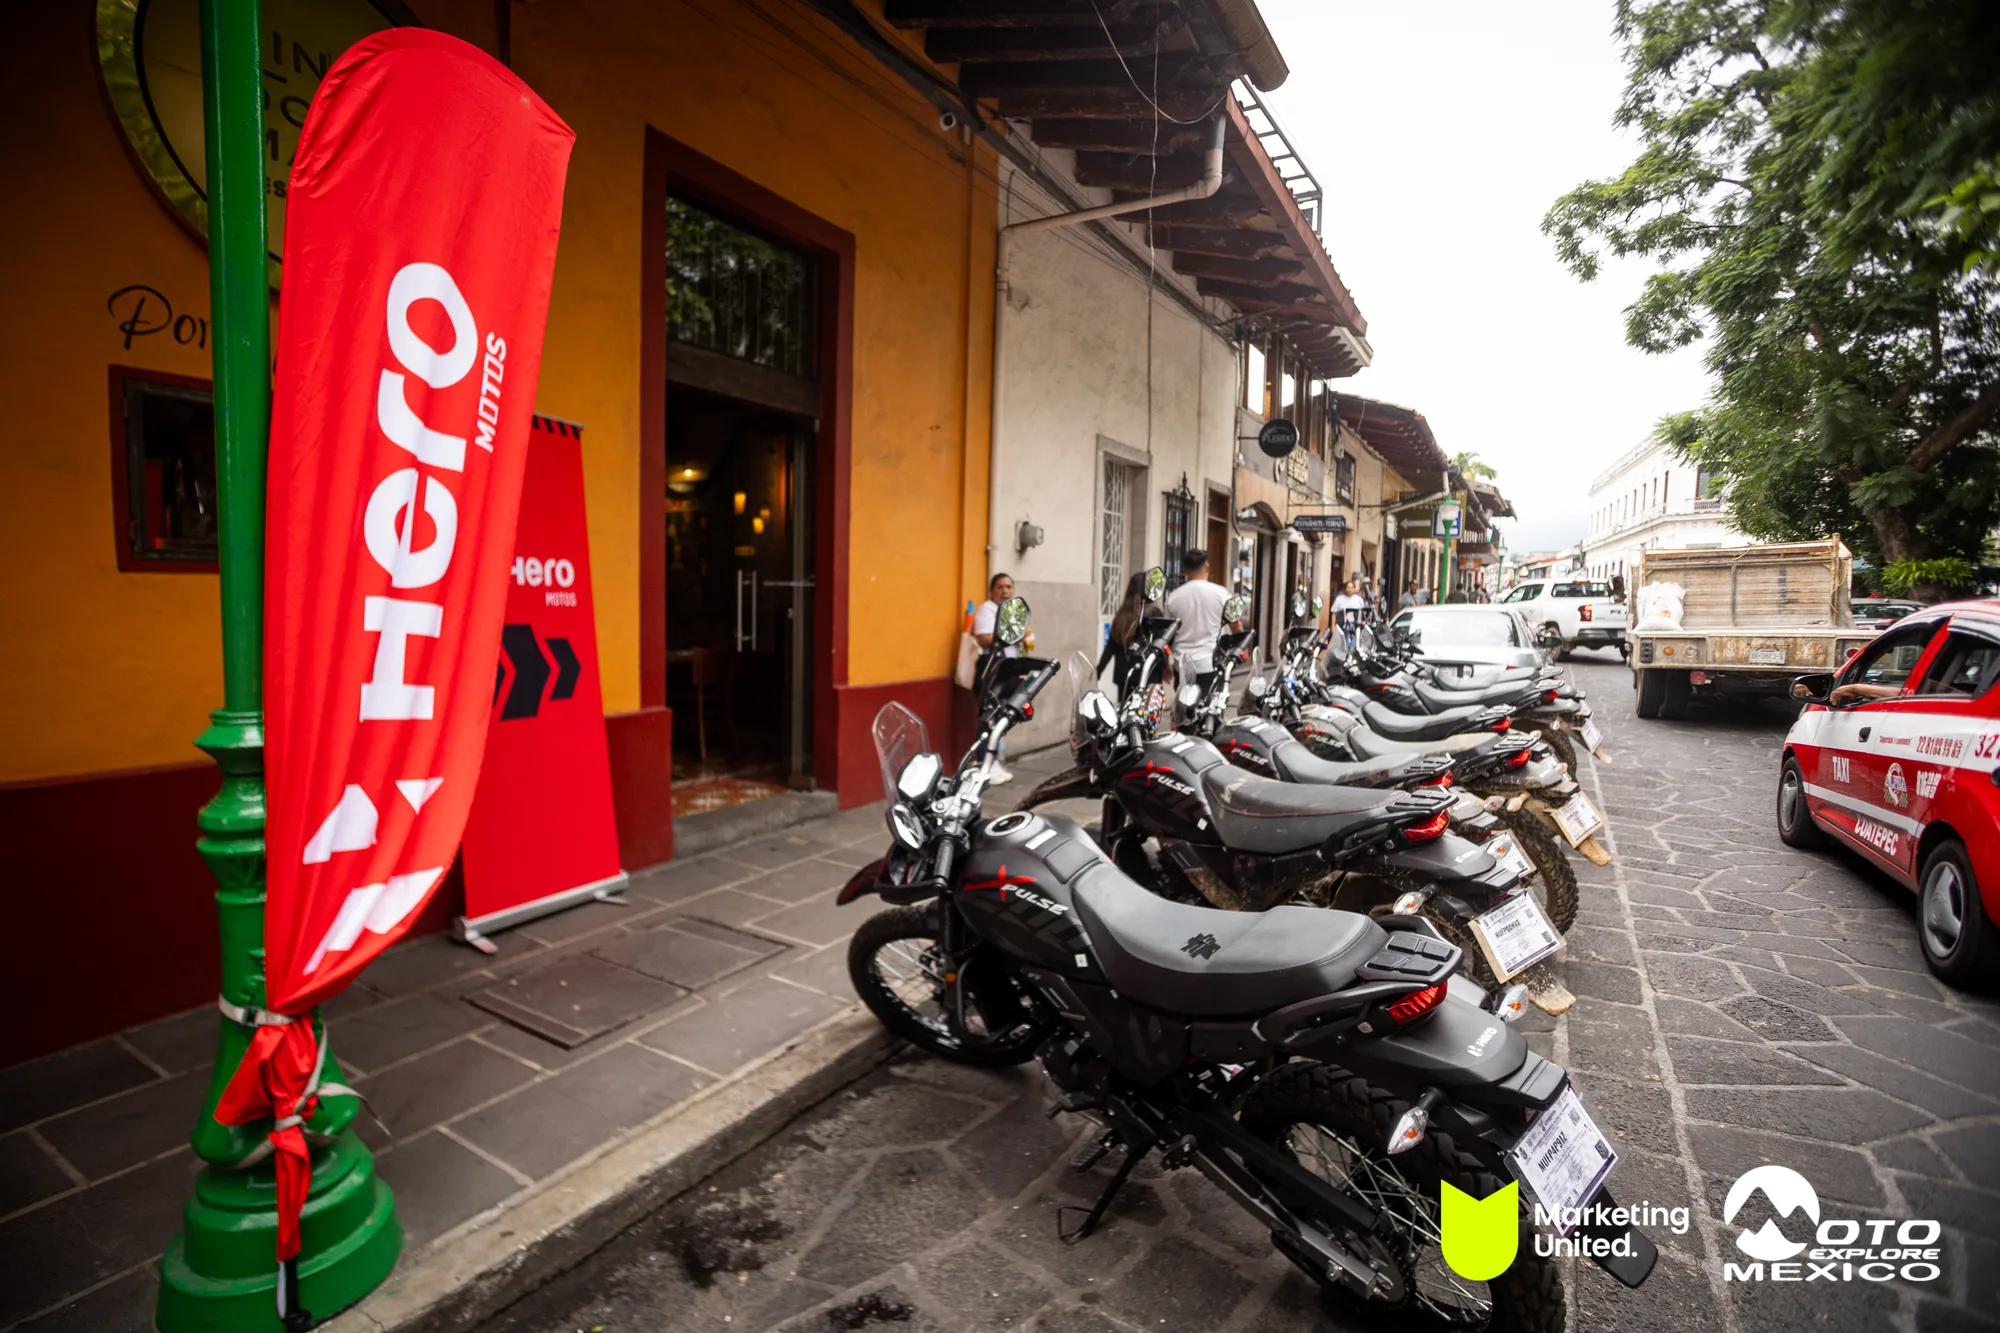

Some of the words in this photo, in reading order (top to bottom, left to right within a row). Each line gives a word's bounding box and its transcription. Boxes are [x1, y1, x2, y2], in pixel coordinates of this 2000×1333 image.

[475, 332, 507, 453] MOTOS
[360, 262, 478, 722] Hero
[545, 591, 577, 607] MOTOS
[1832, 756, 1850, 783] TAXI
[1854, 817, 1899, 856] COATEPEC
